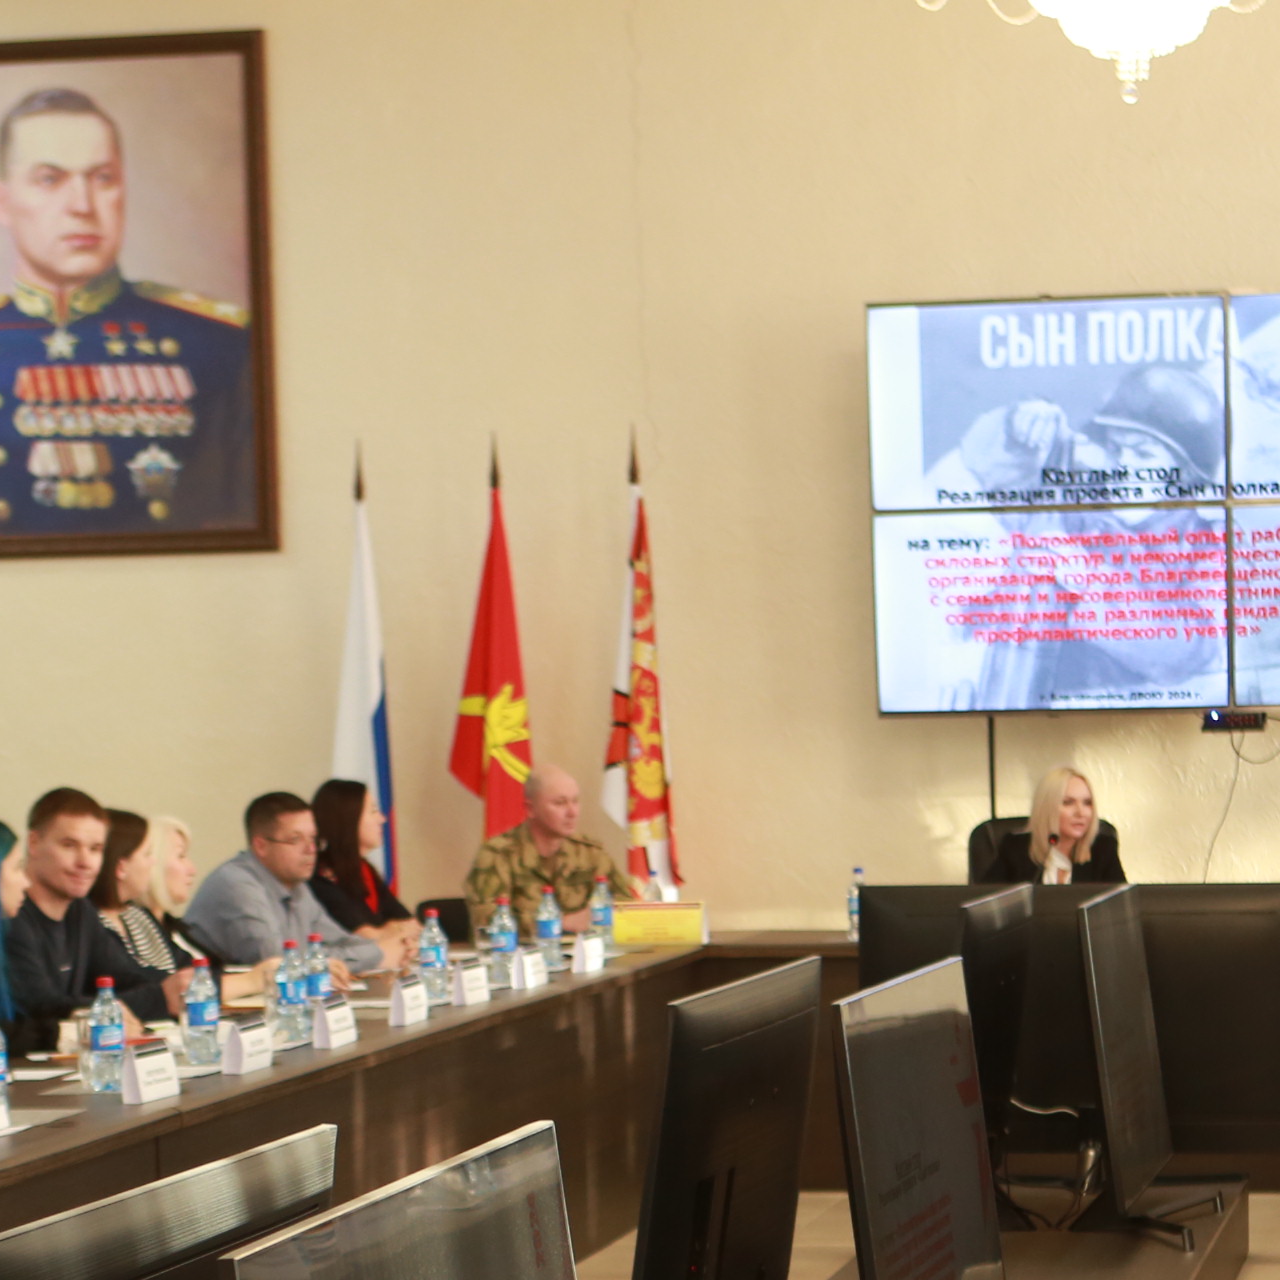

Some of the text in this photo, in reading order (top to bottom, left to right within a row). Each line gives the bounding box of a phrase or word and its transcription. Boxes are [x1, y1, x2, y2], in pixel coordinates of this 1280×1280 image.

[980, 306, 1242, 369] СЫН ПОЛКА
[1042, 465, 1181, 485] Круглый стол
[936, 488, 1056, 505] Реализация
[1062, 484, 1144, 504] проекта
[1151, 482, 1205, 498] «Сын
[907, 539, 930, 551] на
[937, 537, 990, 553] тему:
[999, 526, 1180, 549] «Положительный
[1184, 530, 1244, 547] опыт
[925, 556, 1011, 569] силовых
[1017, 553, 1106, 569] структур
[1111, 551, 1124, 565] и
[1064, 571, 1134, 586] города
[930, 596, 939, 606] с
[946, 592, 1032, 606] семьями
[1038, 592, 1049, 604] и
[945, 610, 1068, 626] состоящими
[1073, 609, 1097, 623] на
[1104, 606, 1215, 624] различных
[974, 622, 1262, 646] профилактического учета»
[1167, 690, 1193, 701] 2024
